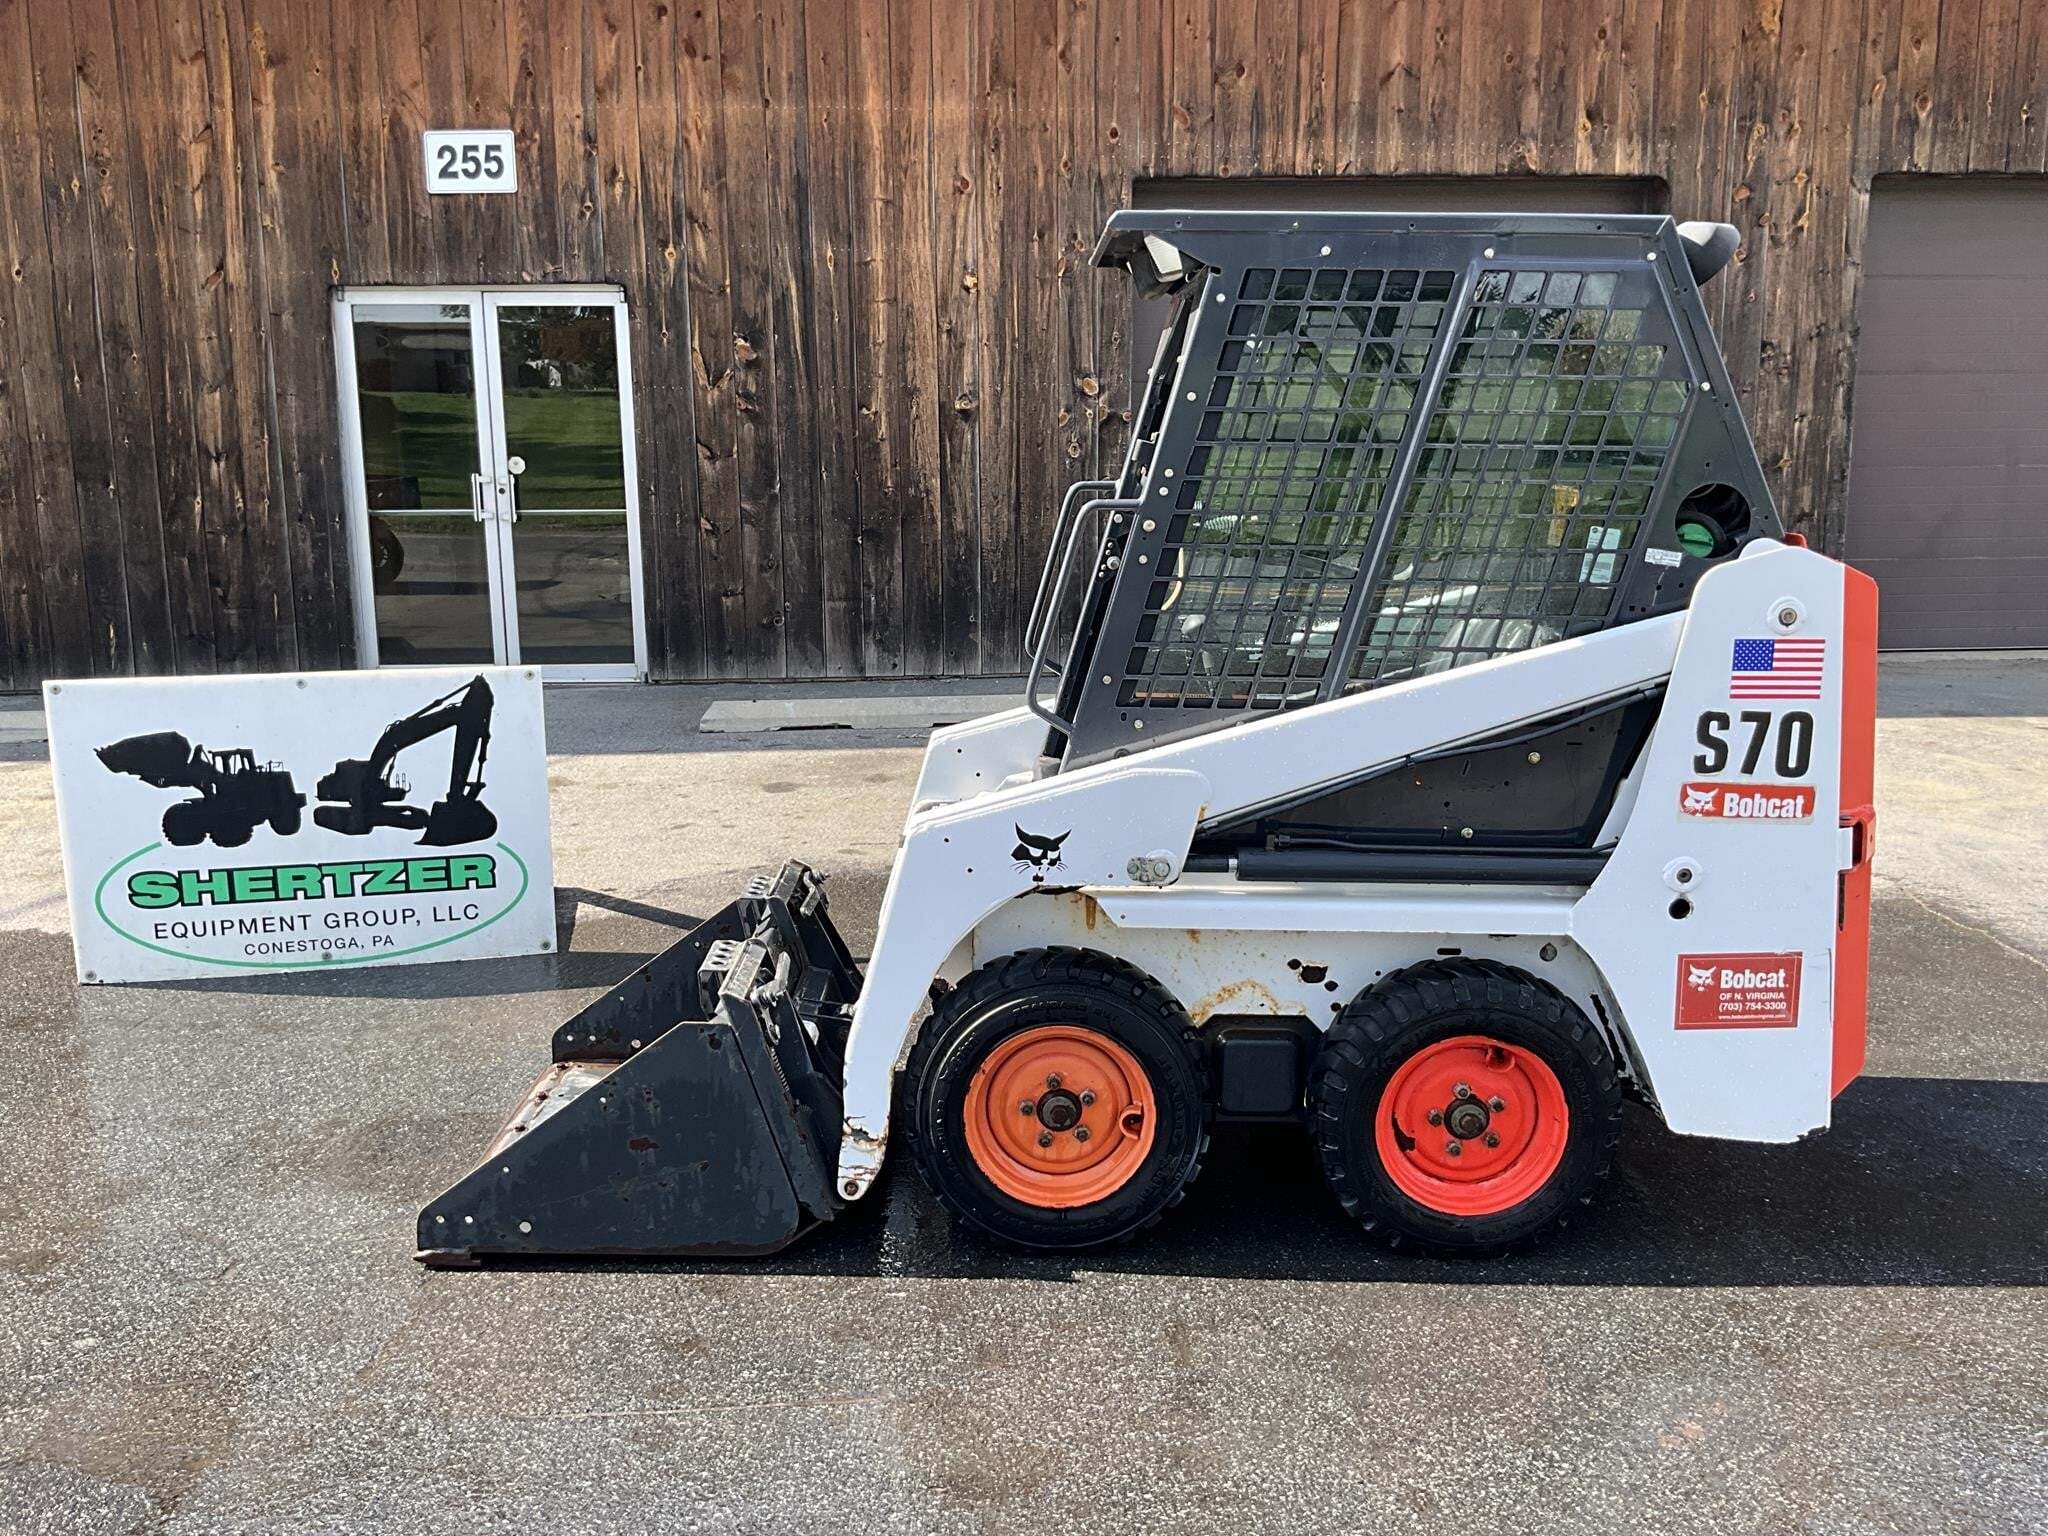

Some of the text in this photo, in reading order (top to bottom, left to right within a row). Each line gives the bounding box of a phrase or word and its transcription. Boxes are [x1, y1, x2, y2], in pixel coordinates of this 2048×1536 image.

[437, 144, 505, 180] 255
[1693, 710, 1814, 778] S70
[1723, 792, 1805, 819] Bobcat
[128, 854, 497, 909] SHERTZER
[154, 903, 480, 940] EQUIPMENT GROUP, LLC
[244, 934, 395, 956] CONESTOGA, PA
[1720, 968, 1786, 989] Bobcat
[1719, 1002, 1742, 1012] (703)
[1720, 992, 1733, 1001] OF
[1746, 991, 1785, 1001] VIRGINIA
